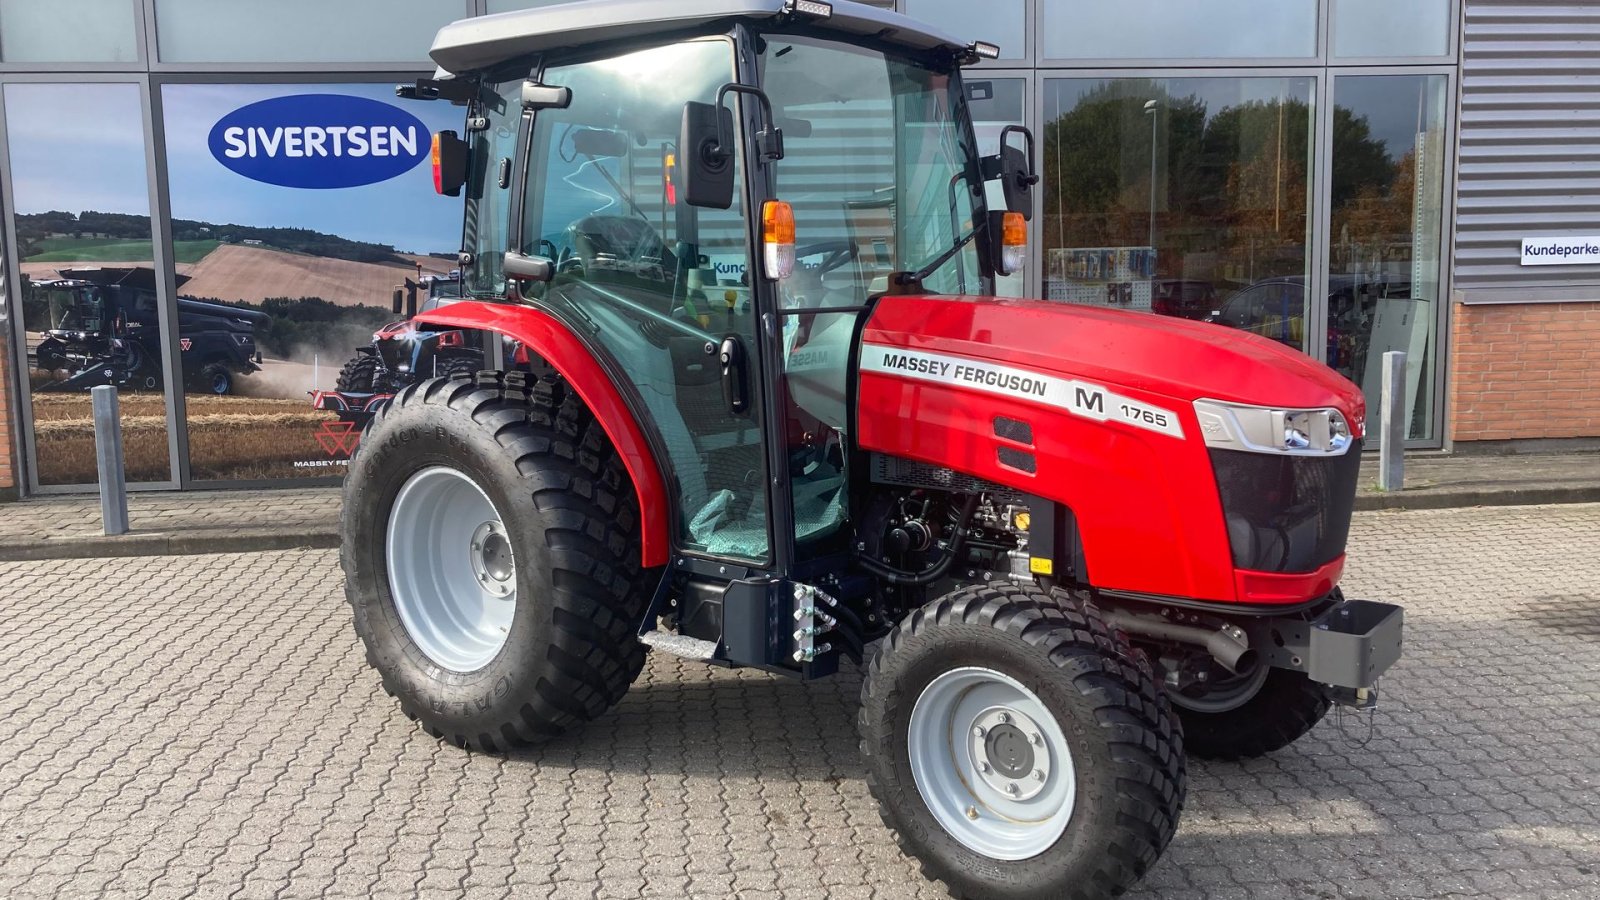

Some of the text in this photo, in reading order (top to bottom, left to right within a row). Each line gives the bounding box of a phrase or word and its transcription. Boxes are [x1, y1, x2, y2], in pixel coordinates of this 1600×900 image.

[224, 126, 418, 158] SIVERTSEN
[1525, 243, 1600, 258] Kundeparke
[883, 353, 1047, 397] MASSEY FERGUSON
[1075, 387, 1104, 414] M
[1120, 405, 1168, 428] 1765
